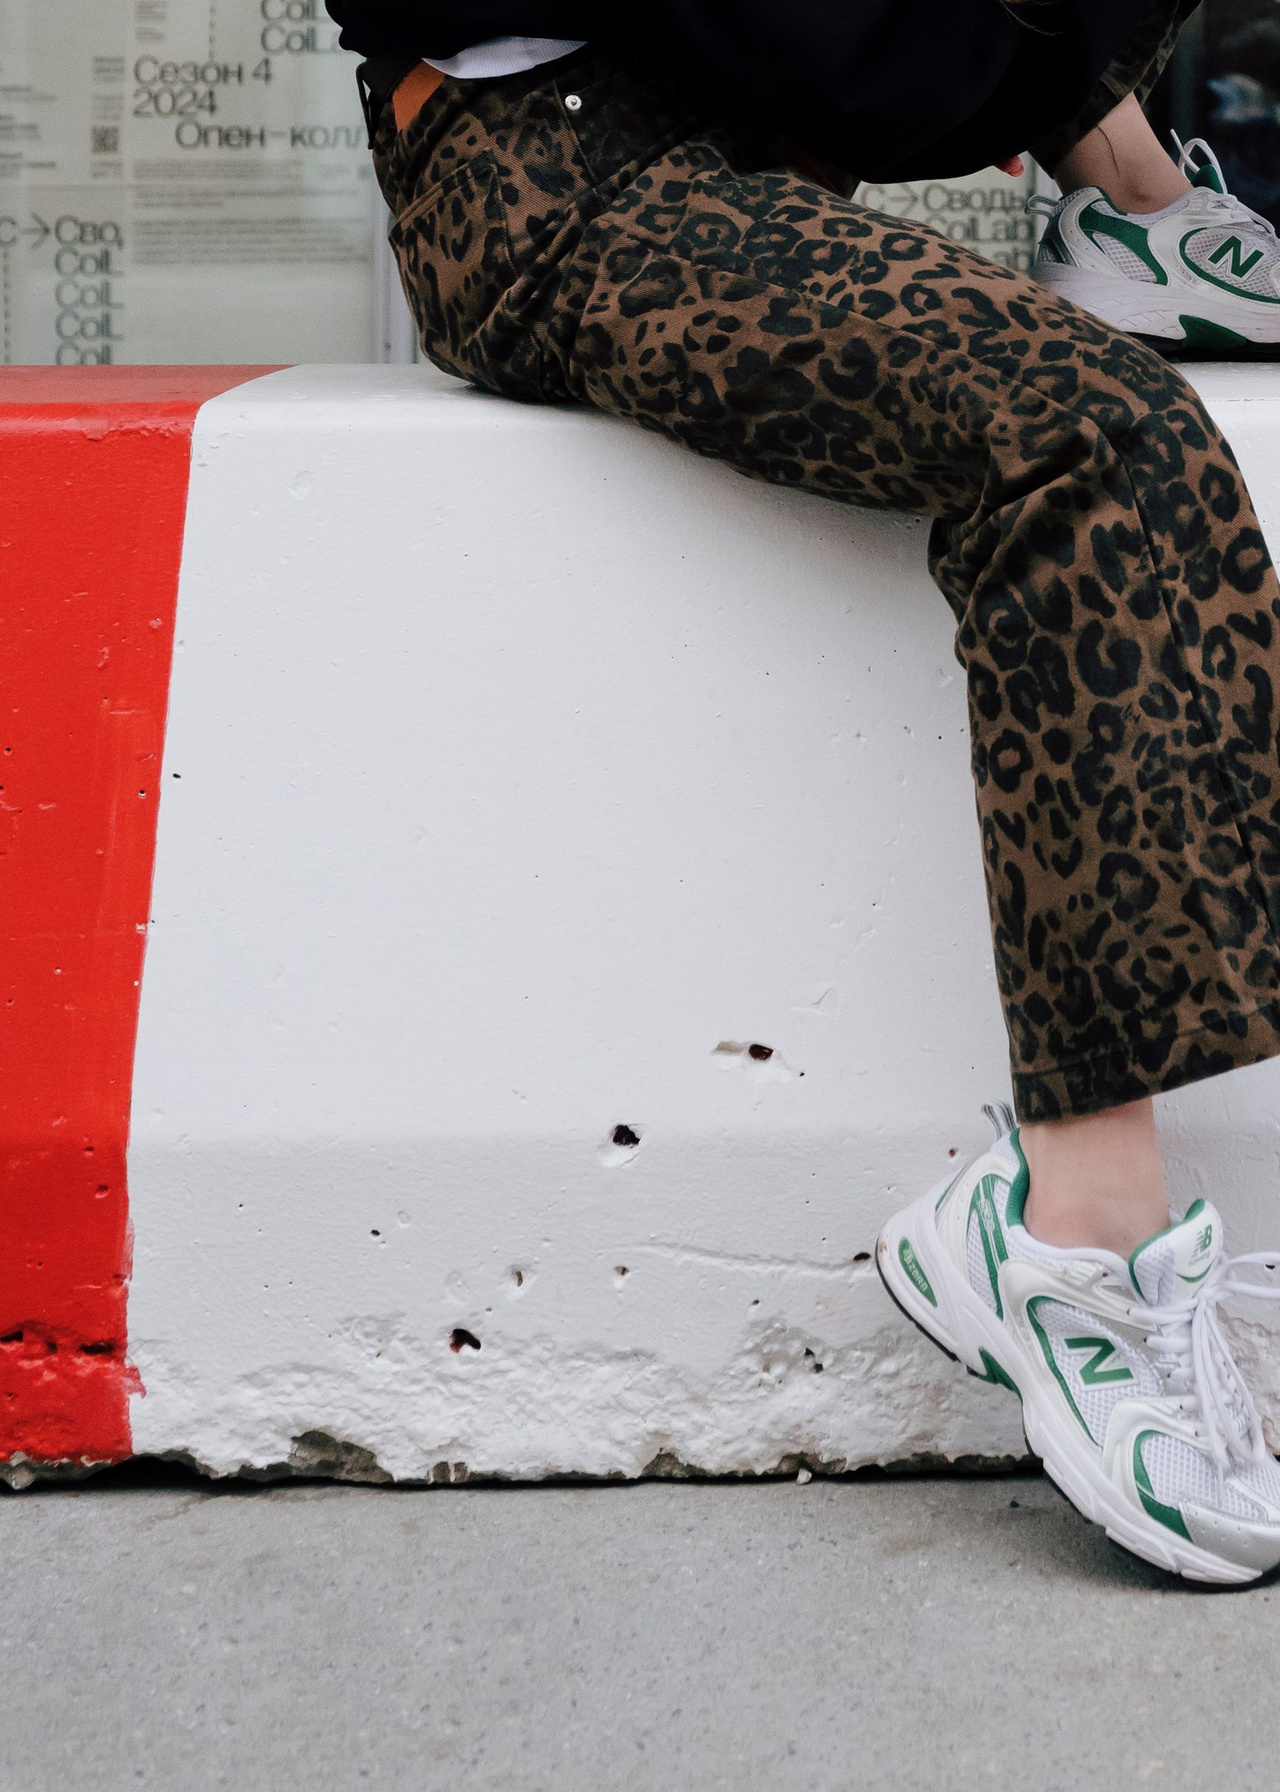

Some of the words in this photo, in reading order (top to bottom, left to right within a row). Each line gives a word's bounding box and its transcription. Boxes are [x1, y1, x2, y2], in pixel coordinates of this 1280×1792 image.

[133, 55, 244, 86] Сезон
[252, 57, 273, 86] 4
[132, 86, 218, 118] 2024
[1207, 234, 1266, 279] N
[1064, 1336, 1136, 1392] N
